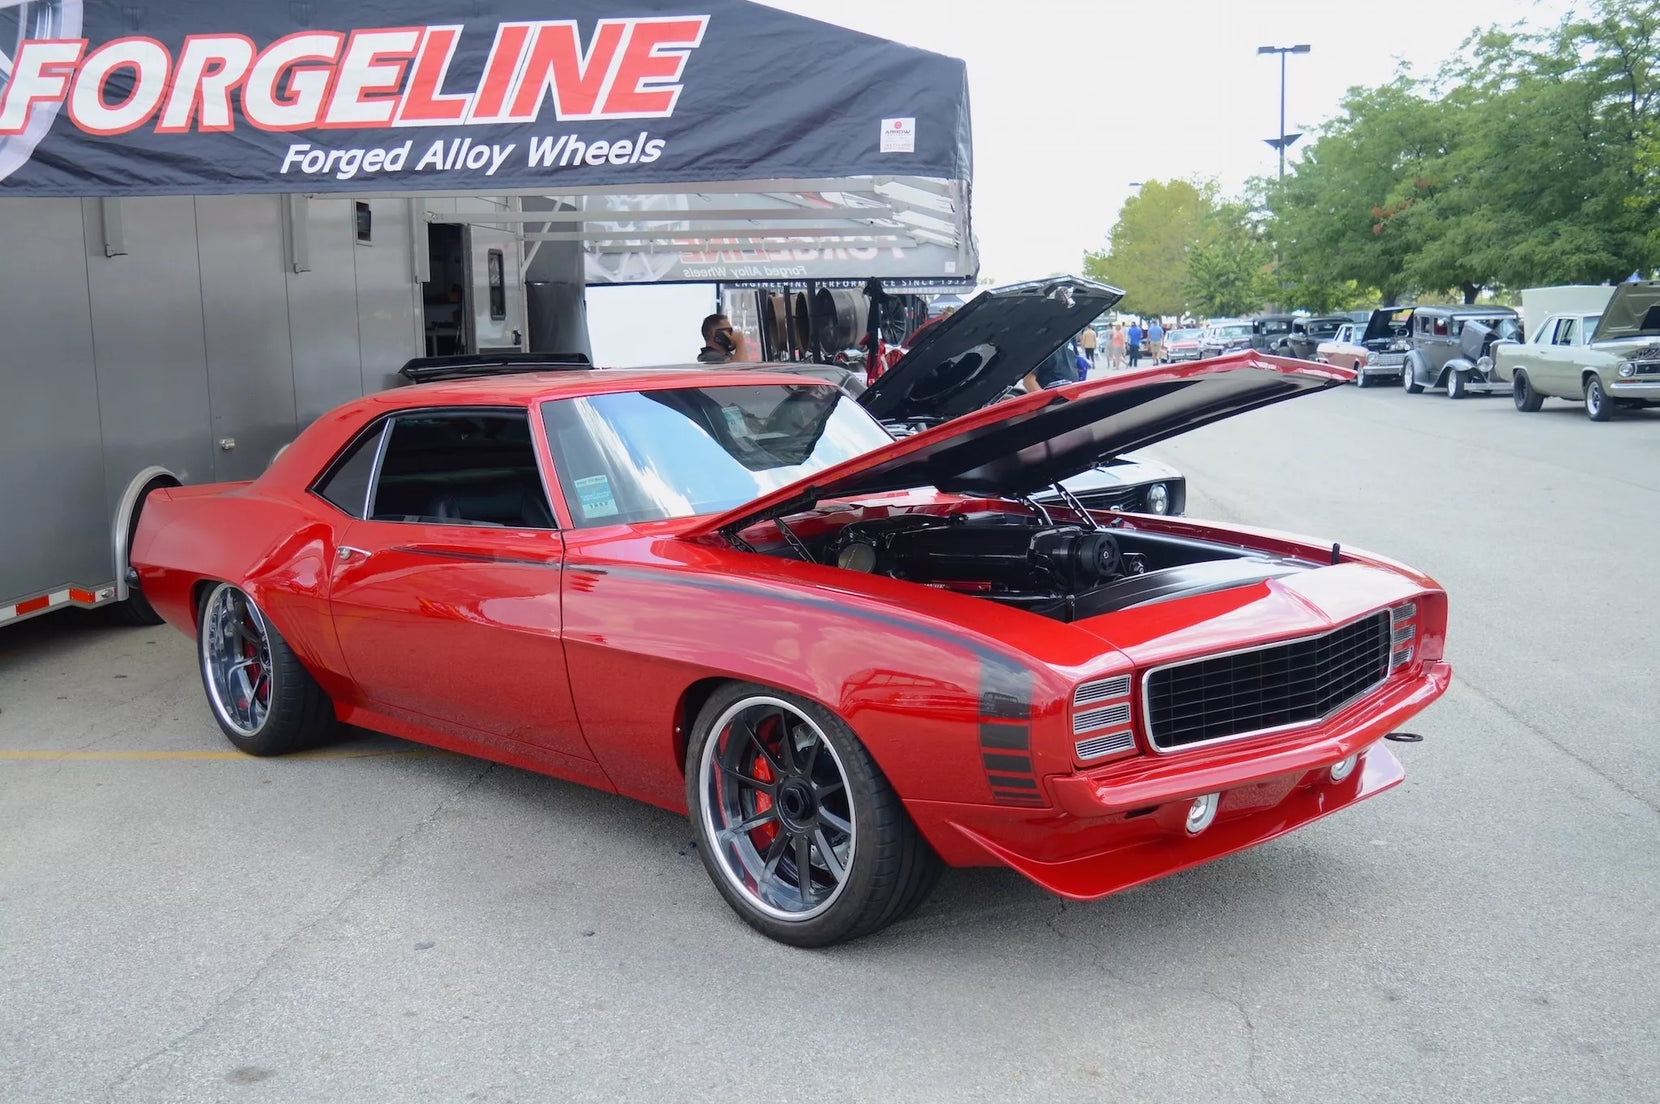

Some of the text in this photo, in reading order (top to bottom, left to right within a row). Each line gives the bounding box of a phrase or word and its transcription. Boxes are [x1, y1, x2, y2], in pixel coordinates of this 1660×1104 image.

[0, 14, 711, 136] FORGELINE
[280, 131, 666, 180] Forged Alloy Wheels
[815, 280, 896, 288] PERFORMCE
